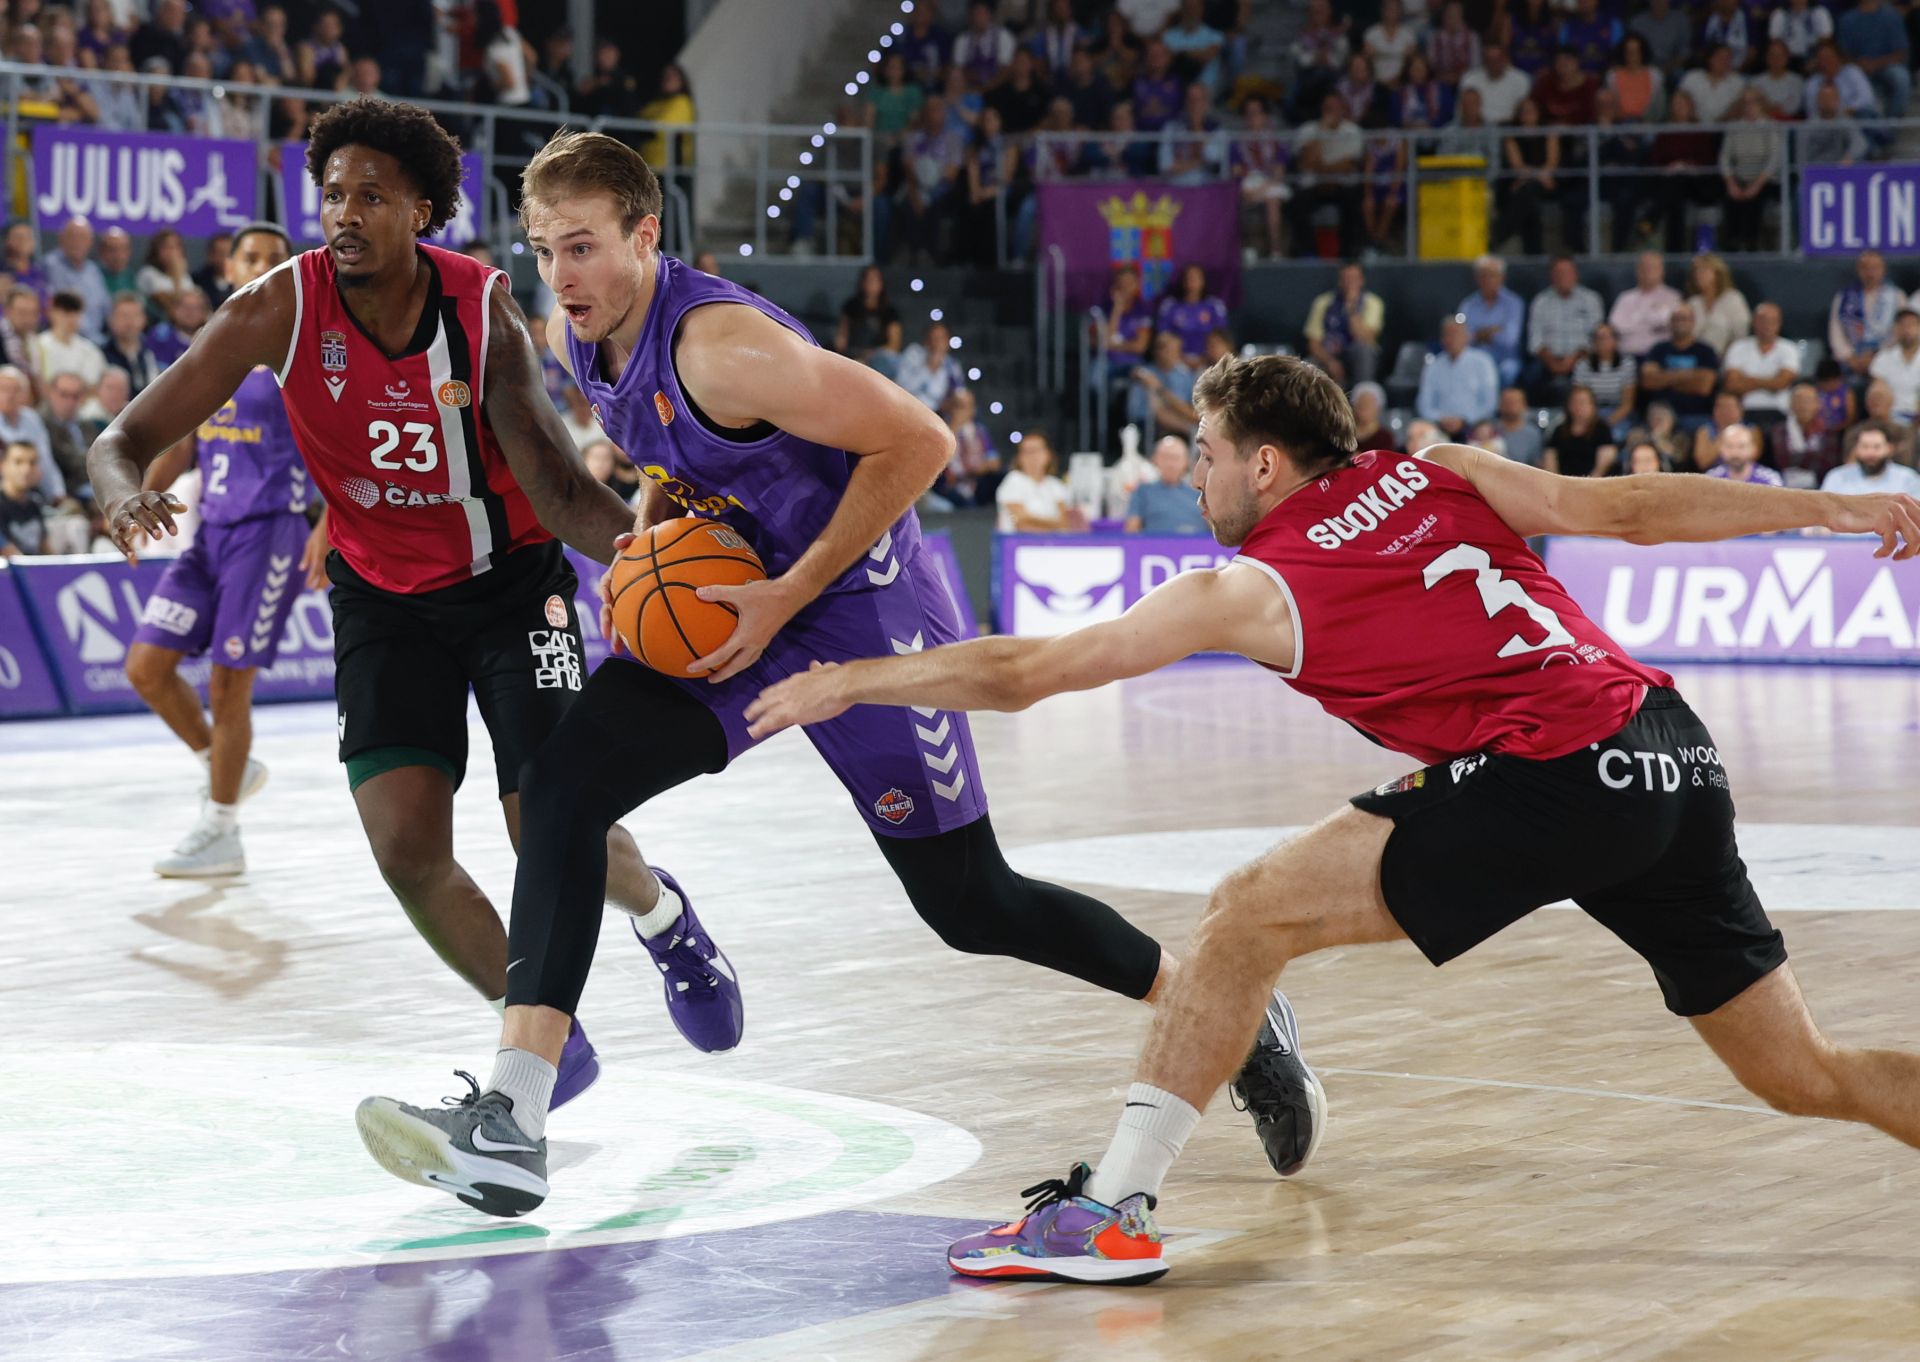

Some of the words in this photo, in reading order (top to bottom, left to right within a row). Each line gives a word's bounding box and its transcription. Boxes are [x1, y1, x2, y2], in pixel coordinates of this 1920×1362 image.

[38, 142, 187, 223] JULUIS
[1809, 171, 1916, 249] CLÍN
[207, 453, 230, 495] 2
[368, 420, 438, 472] 23
[1306, 461, 1430, 550] SUOKAS
[1422, 543, 1576, 658] 3
[1603, 548, 1920, 649] URMA
[877, 800, 912, 814] PALENCIA
[1598, 748, 1681, 793] CTD
